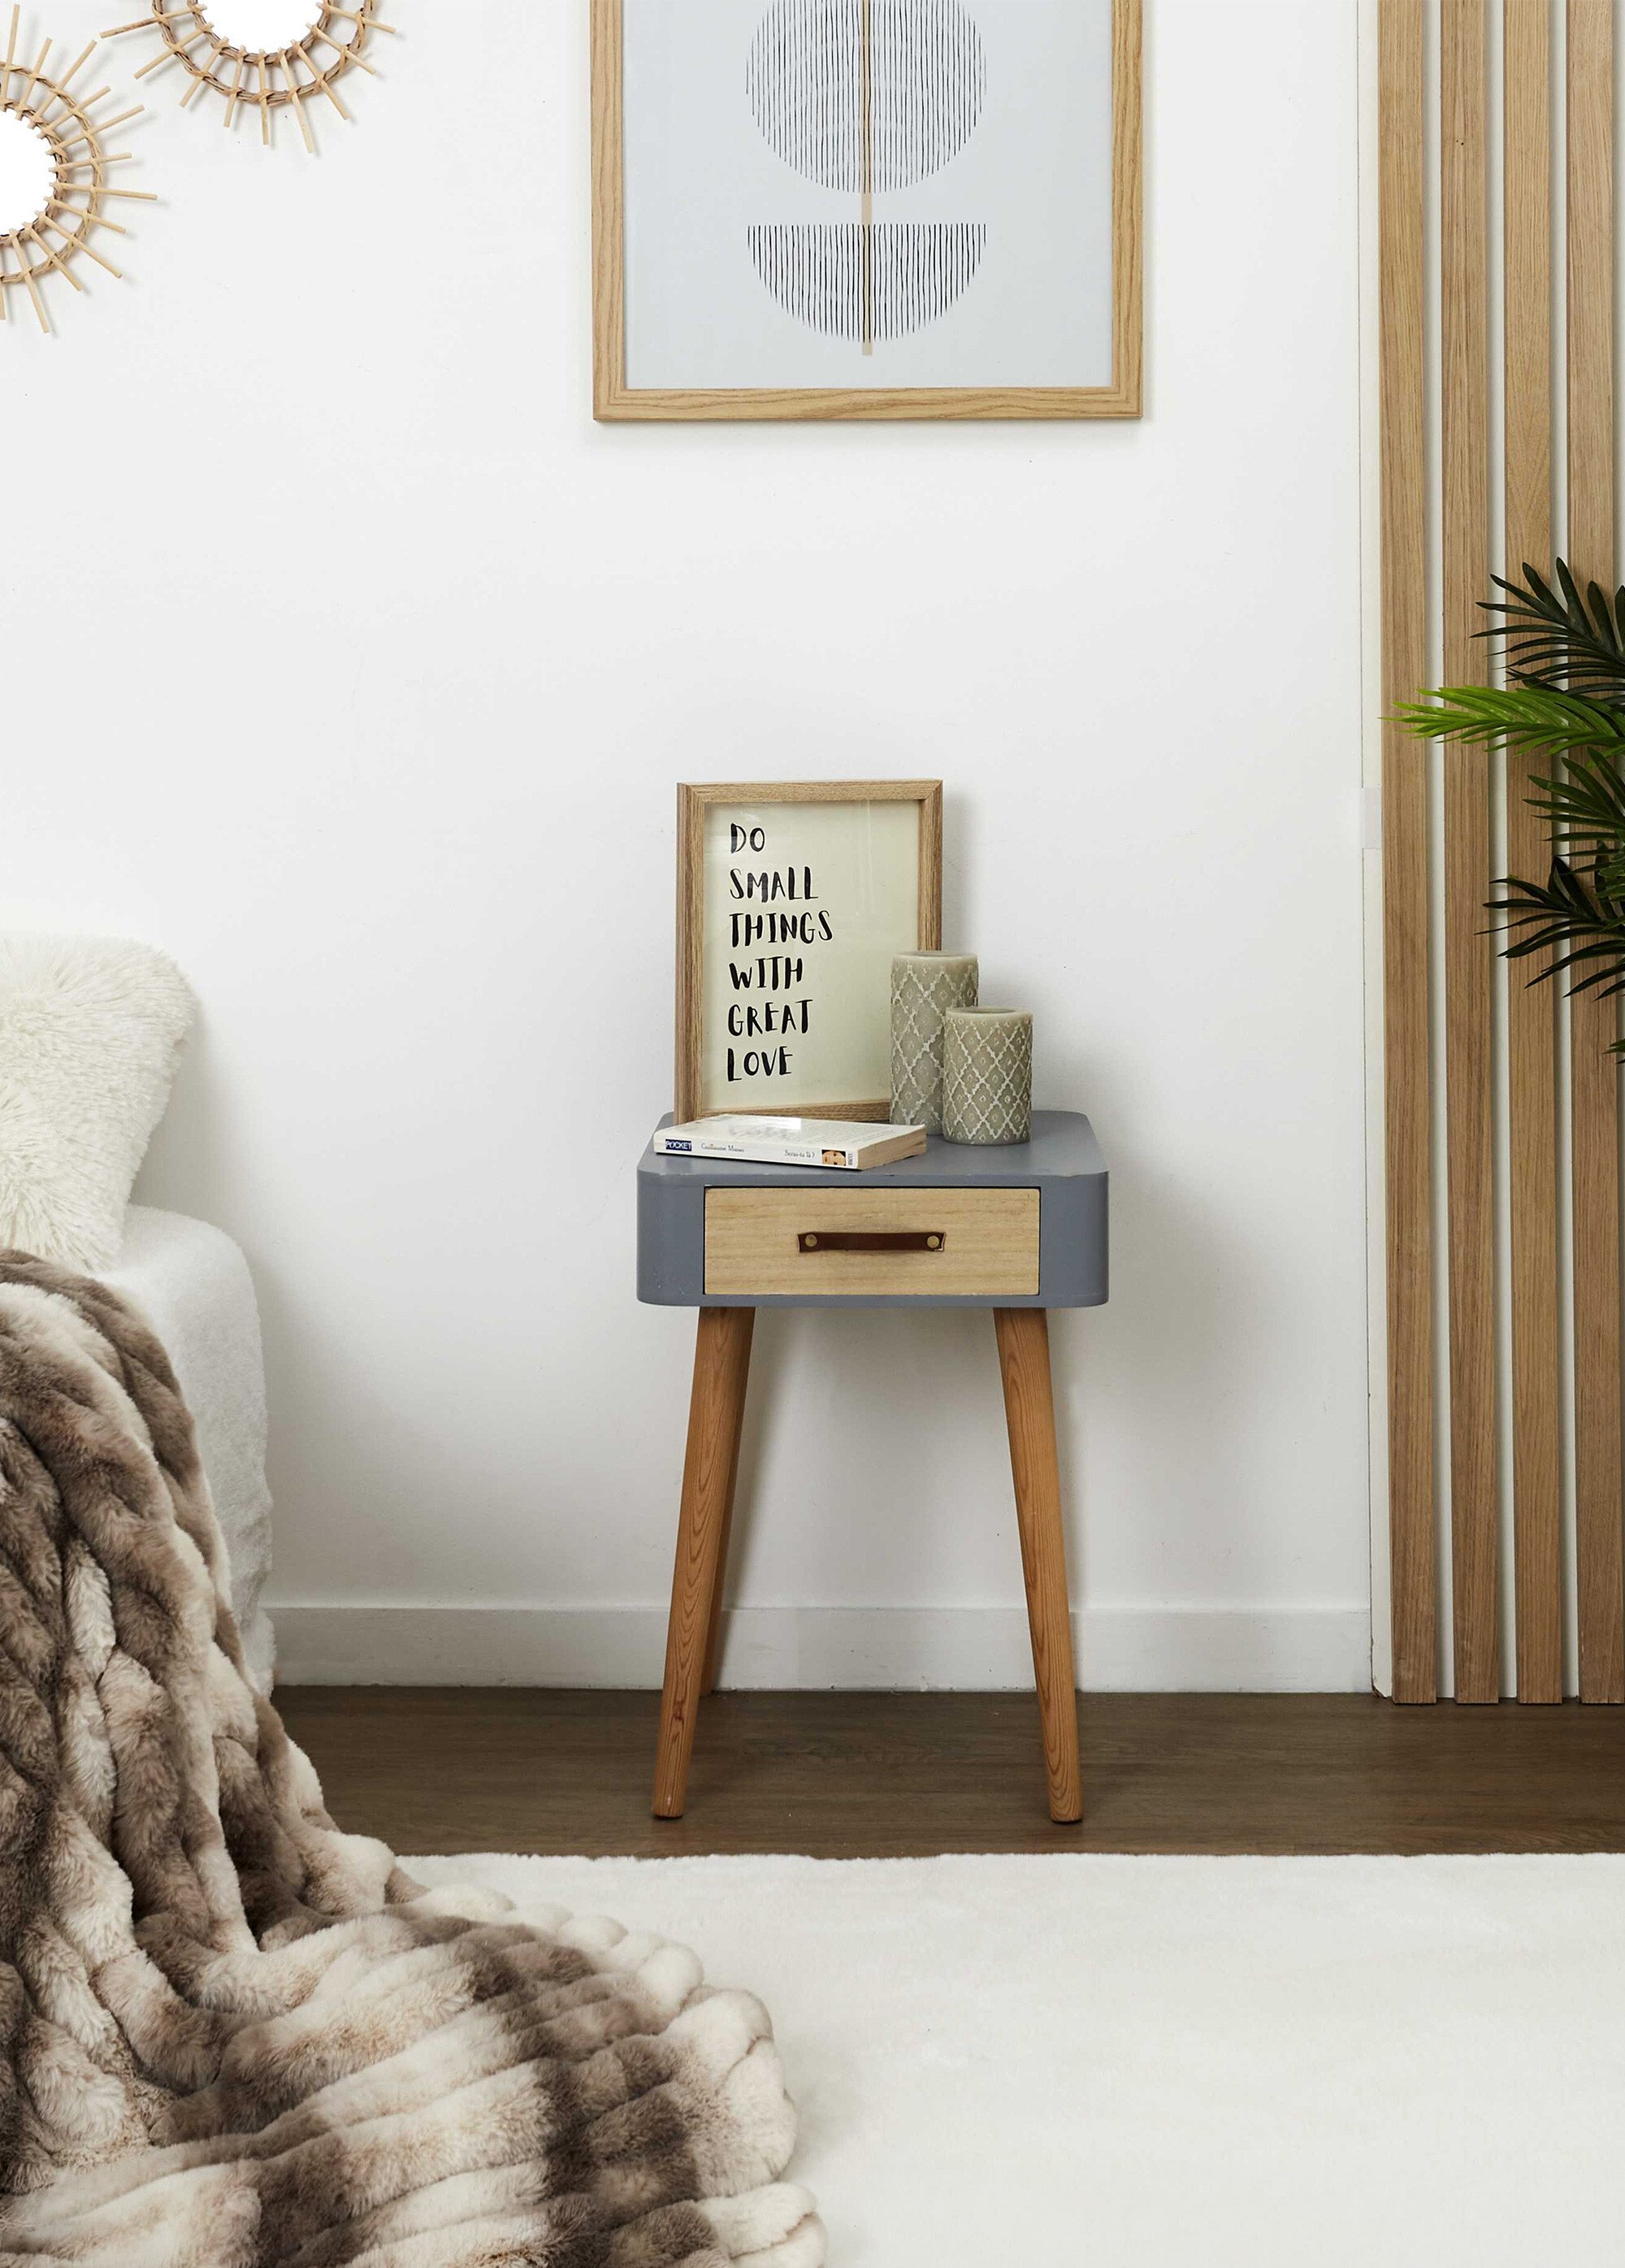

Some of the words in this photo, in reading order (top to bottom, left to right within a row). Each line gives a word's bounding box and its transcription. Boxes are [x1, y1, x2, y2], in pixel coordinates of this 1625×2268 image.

[730, 822, 765, 854] DO
[730, 865, 819, 903] SMALL
[729, 910, 833, 948] THINGS
[729, 956, 803, 991] WITH
[727, 999, 813, 1037] GREAT
[727, 1045, 793, 1082] LOVE
[665, 1140, 691, 1151] POCKET
